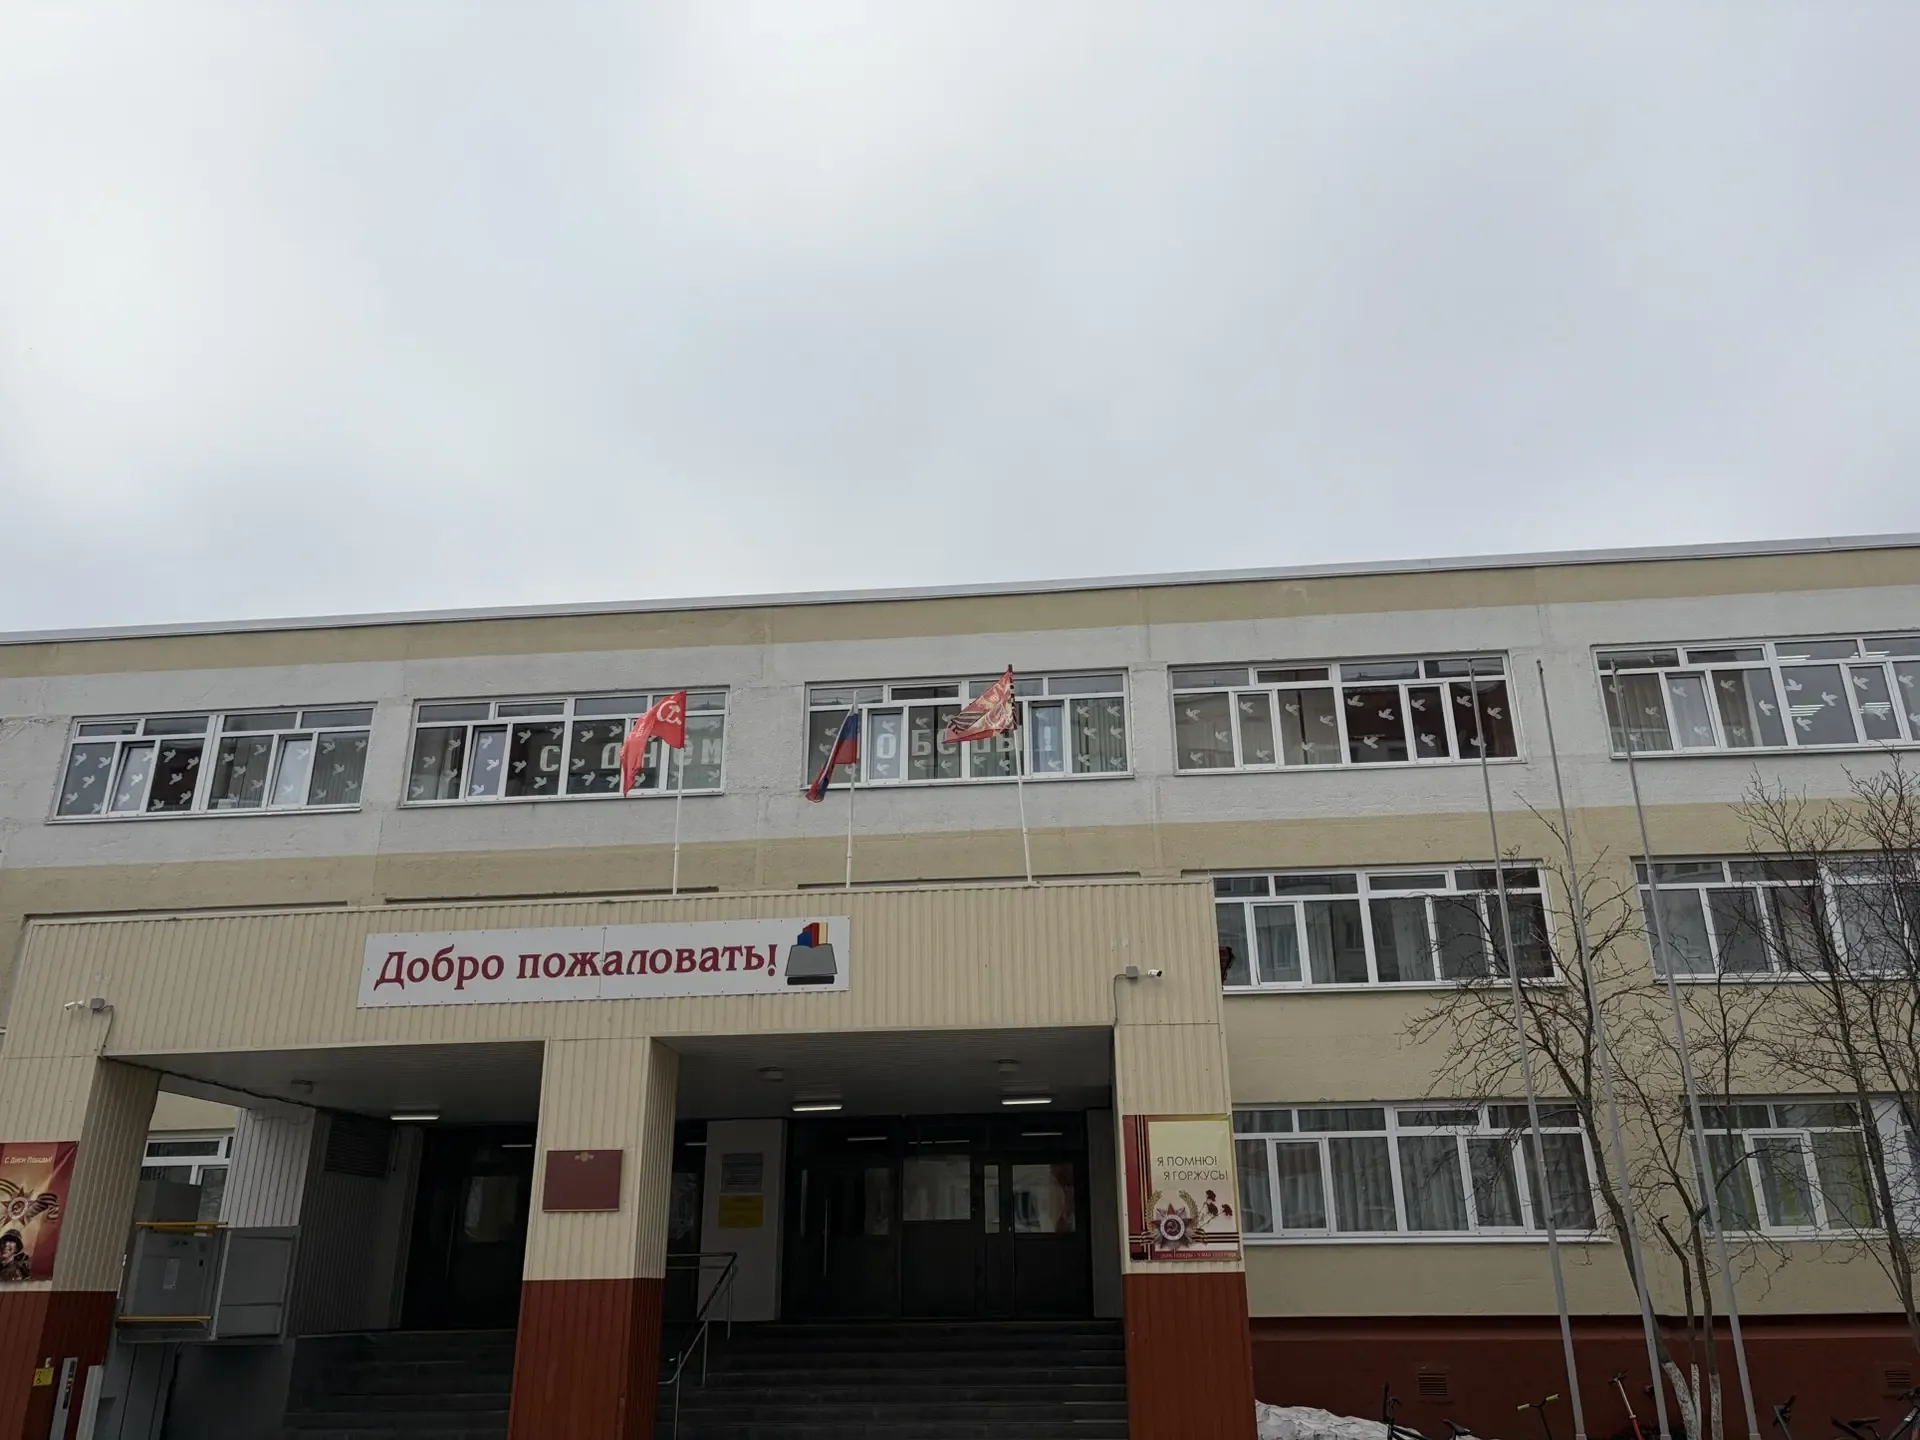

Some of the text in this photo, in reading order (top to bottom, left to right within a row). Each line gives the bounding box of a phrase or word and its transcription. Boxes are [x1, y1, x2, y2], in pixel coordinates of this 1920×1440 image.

[539, 744, 560, 772] С
[373, 945, 778, 990] Добро пожаловать!
[1157, 1155, 1217, 1167] Я ПОМНЮ!
[1163, 1169, 1229, 1181] Я ГОРЖУСЬ!
